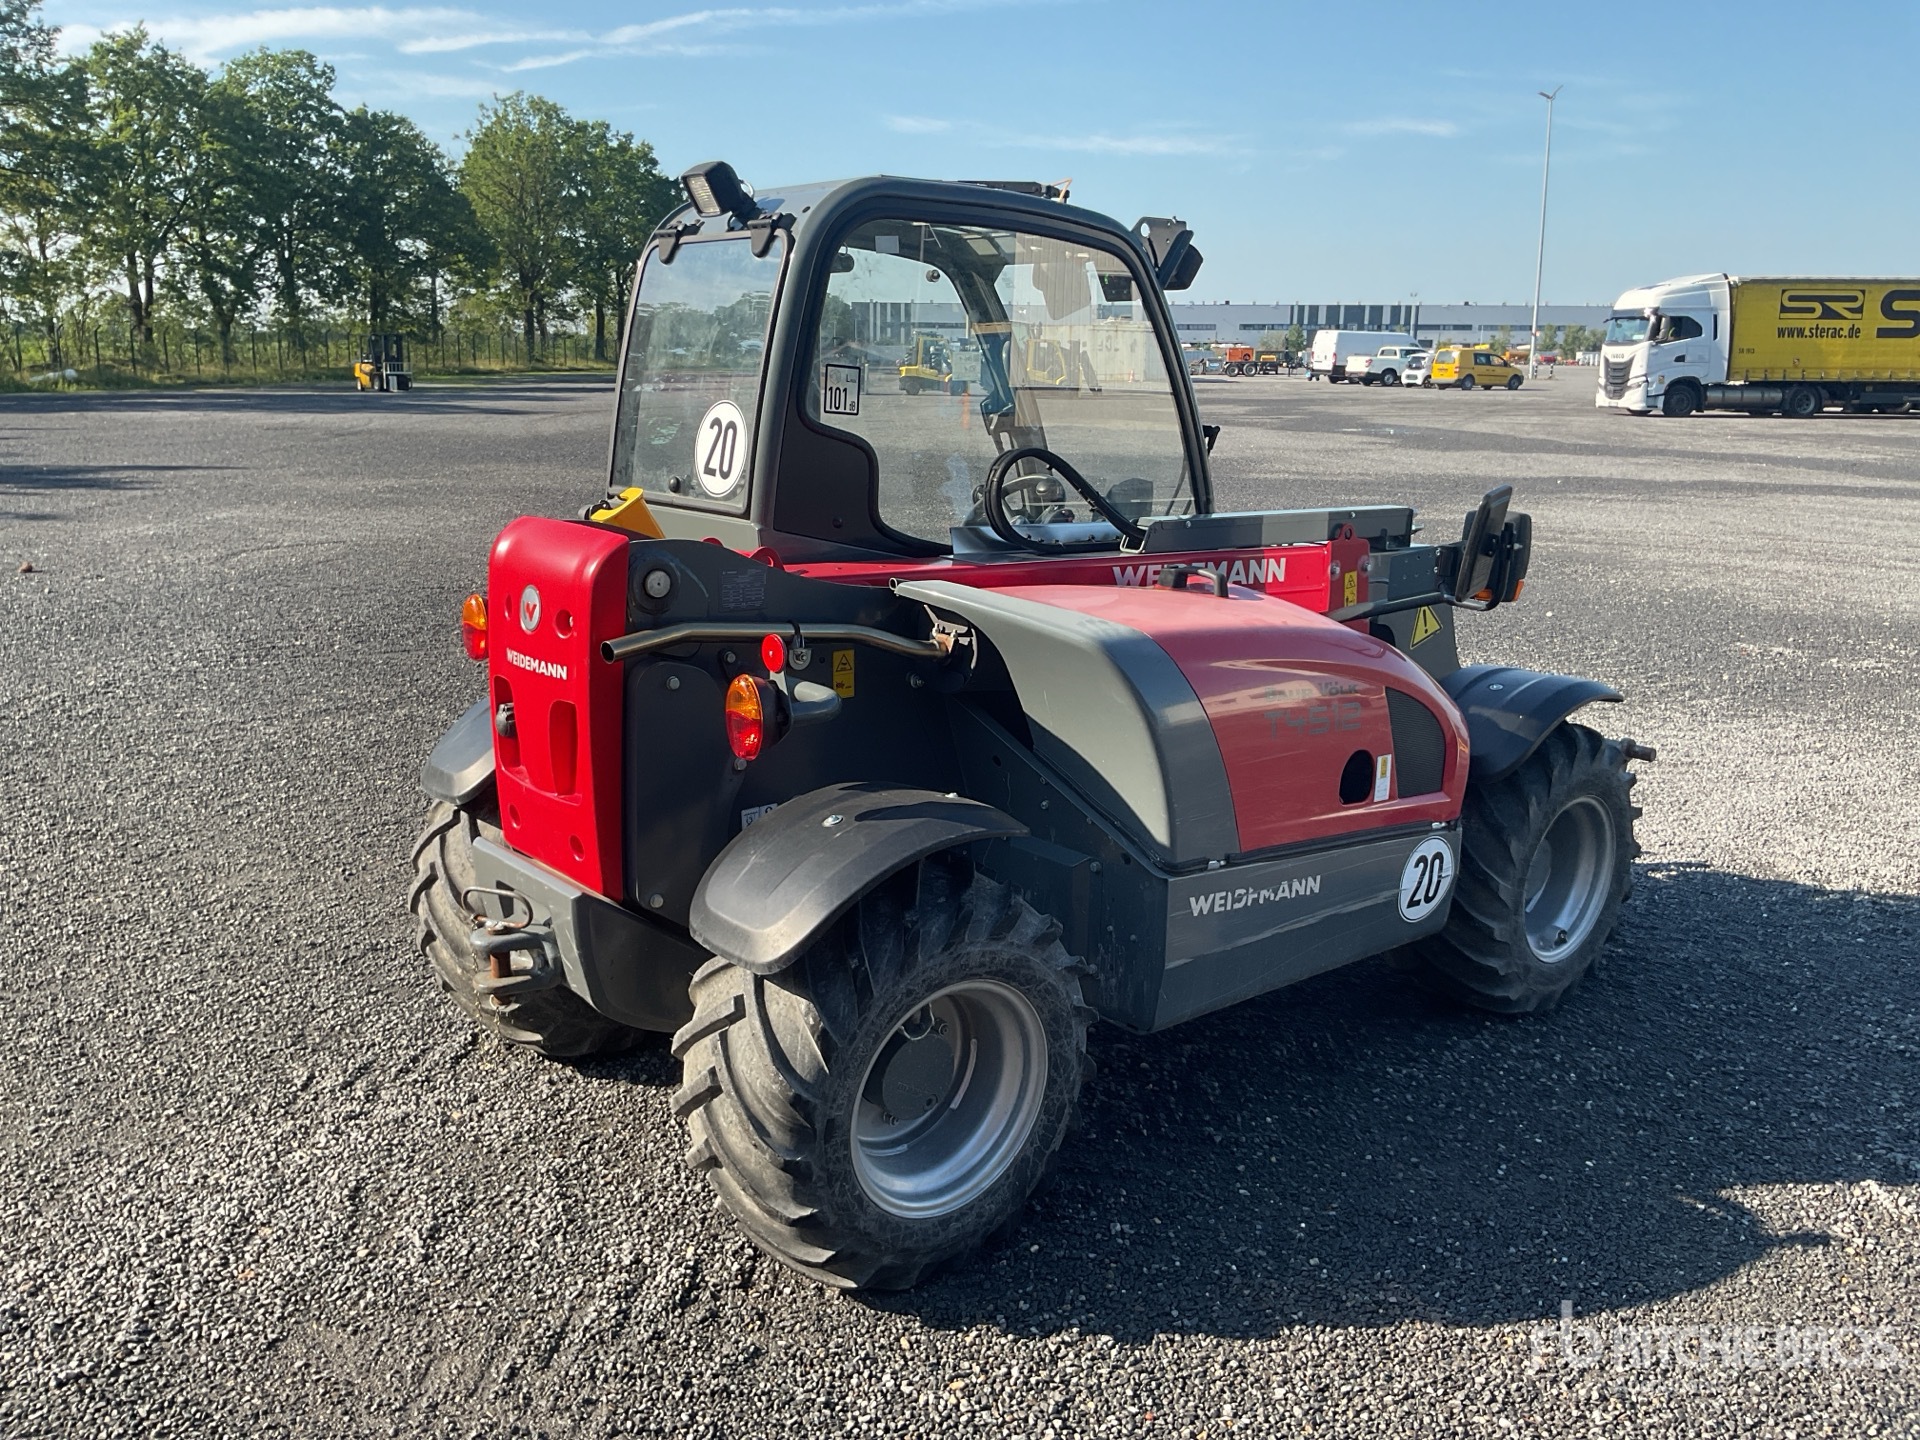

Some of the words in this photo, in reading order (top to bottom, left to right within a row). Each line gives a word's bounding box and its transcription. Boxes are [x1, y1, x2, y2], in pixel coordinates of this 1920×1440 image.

[1777, 323, 1861, 338] www.sterac.de
[1876, 289, 1920, 338] S
[828, 386, 848, 411] 101
[703, 417, 738, 480] 20
[1112, 557, 1286, 588] WEMANN
[506, 647, 568, 681] WEIDEMANN
[1264, 700, 1362, 740] T4512
[1406, 851, 1445, 910] 20
